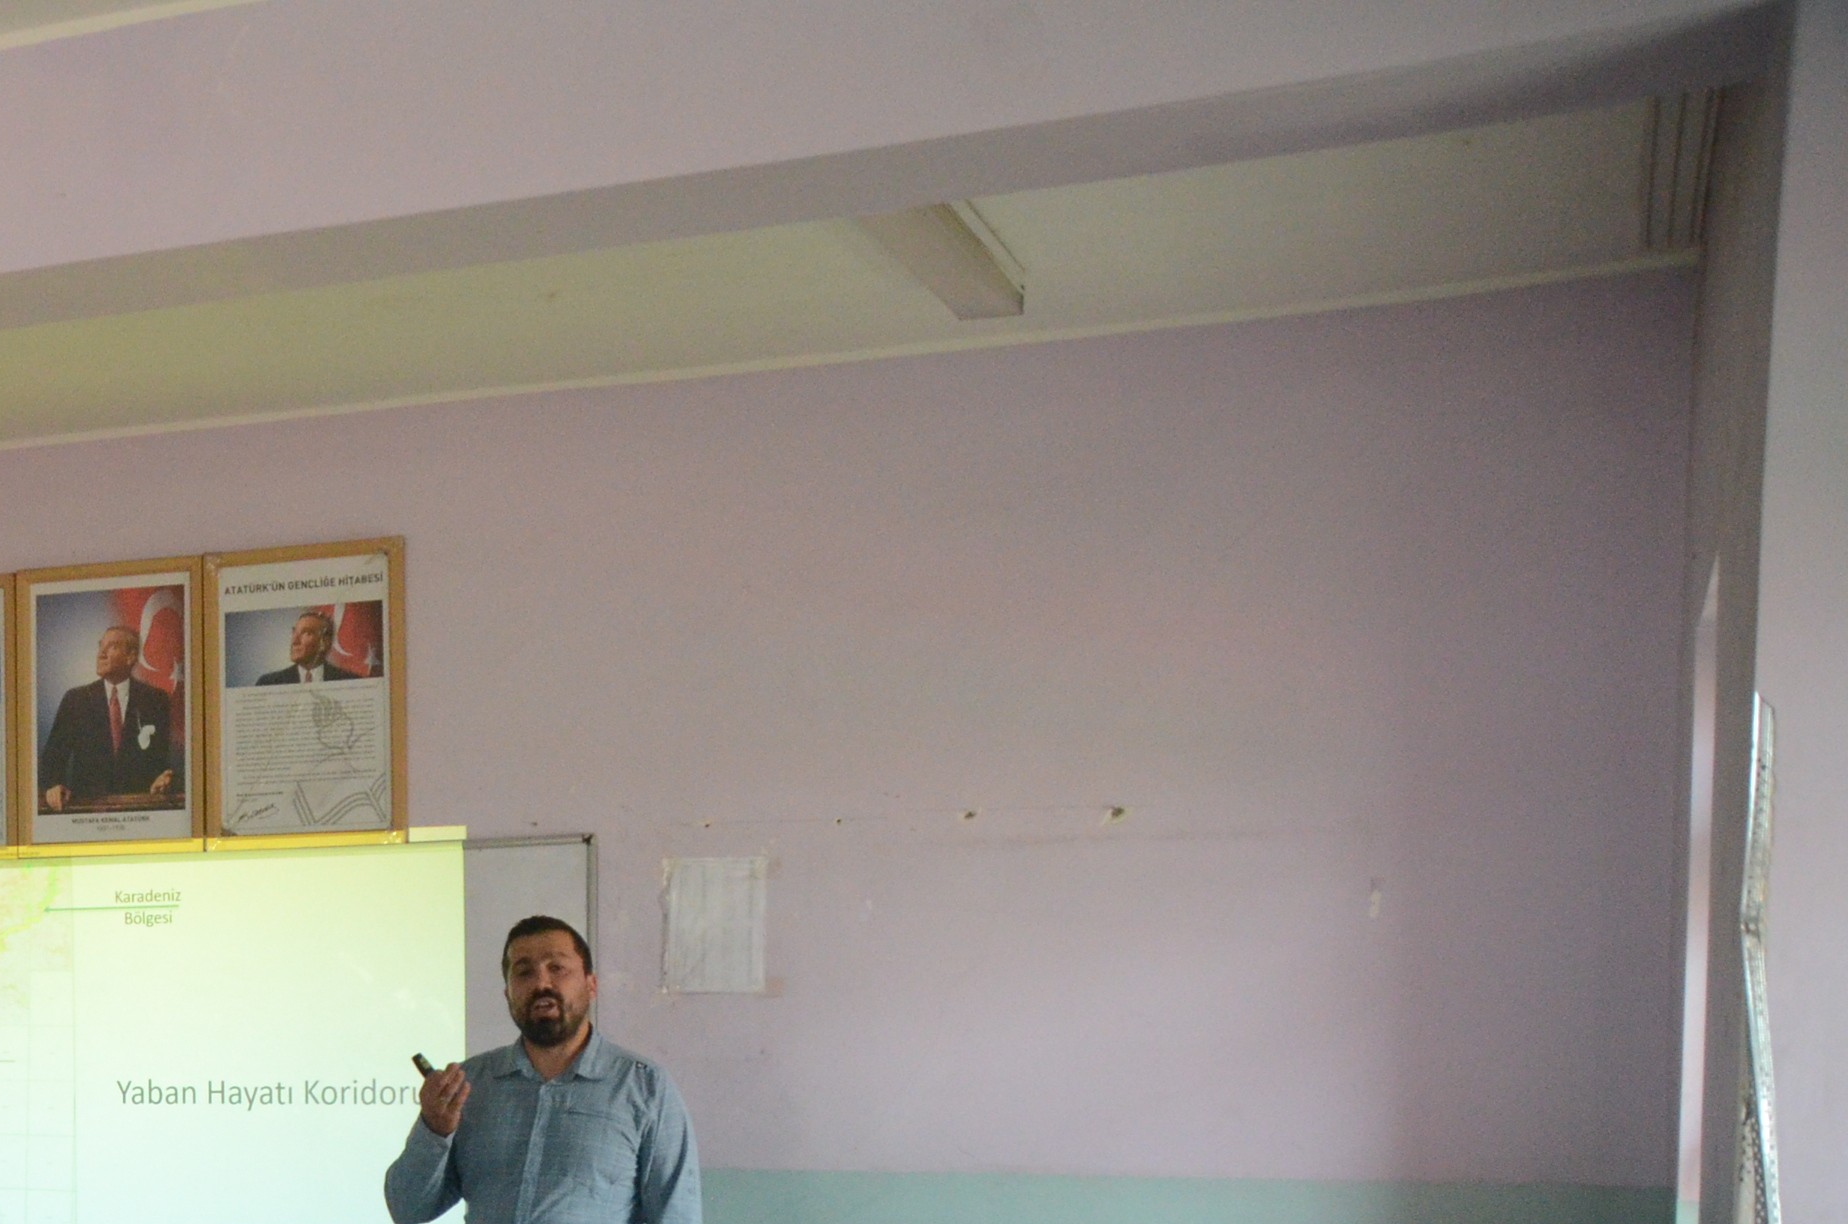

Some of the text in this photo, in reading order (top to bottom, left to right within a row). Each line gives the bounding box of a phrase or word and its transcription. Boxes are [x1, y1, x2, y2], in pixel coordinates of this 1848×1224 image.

[114, 887, 182, 903] Karadeniz
[124, 910, 173, 927] Bölgesi
[116, 1078, 197, 1106] Yaban
[208, 1080, 293, 1111] Hayatı
